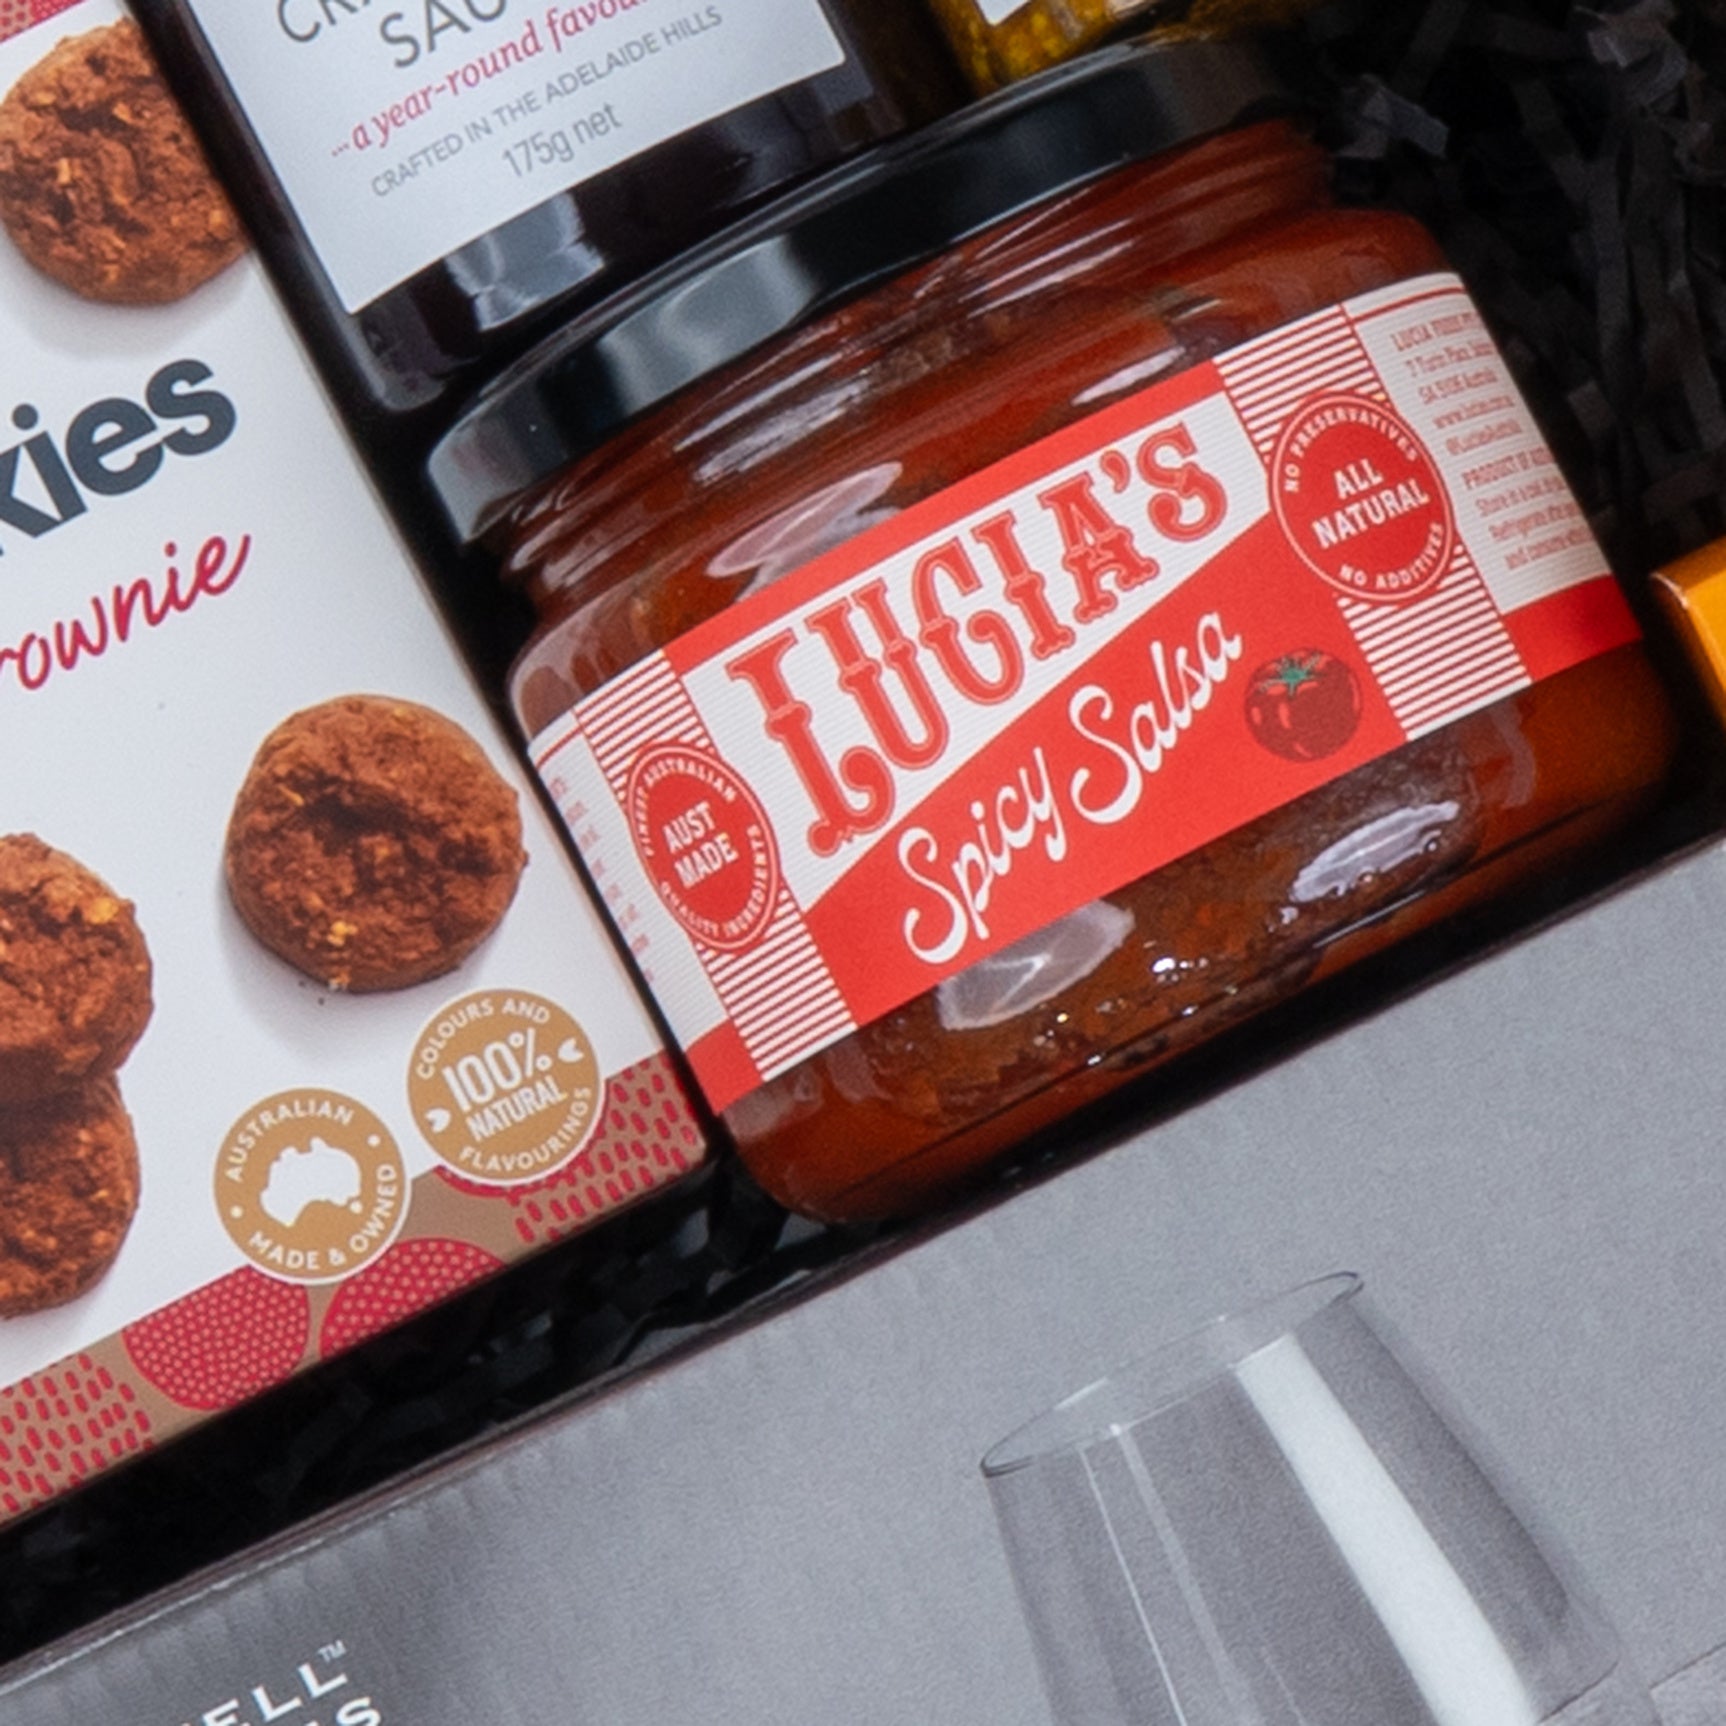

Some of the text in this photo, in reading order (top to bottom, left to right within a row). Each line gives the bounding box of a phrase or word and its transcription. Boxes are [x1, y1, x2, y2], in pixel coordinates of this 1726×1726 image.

[371, 19, 544, 149] year-round
[371, 5, 723, 197] CRAFTED IN THE ADELAIDE HILLS
[502, 103, 623, 178] 175g net
[1312, 478, 1430, 549] NATURAL
[1334, 458, 1384, 499] ALL
[1340, 564, 1367, 586] NO
[724, 421, 1228, 857] LUCIA'S
[662, 800, 716, 855] AUST
[898, 611, 1242, 963] Spicy Salsa
[673, 832, 739, 889] MADE
[416, 998, 551, 1080] COLOURS AND
[442, 1026, 553, 1112] 100%
[225, 1099, 355, 1182] AUSTRALIAN
[459, 1086, 592, 1173] FLAVOURINGS
[466, 1074, 568, 1142] NATURAL
[248, 1163, 398, 1270] MADE & OWNED
